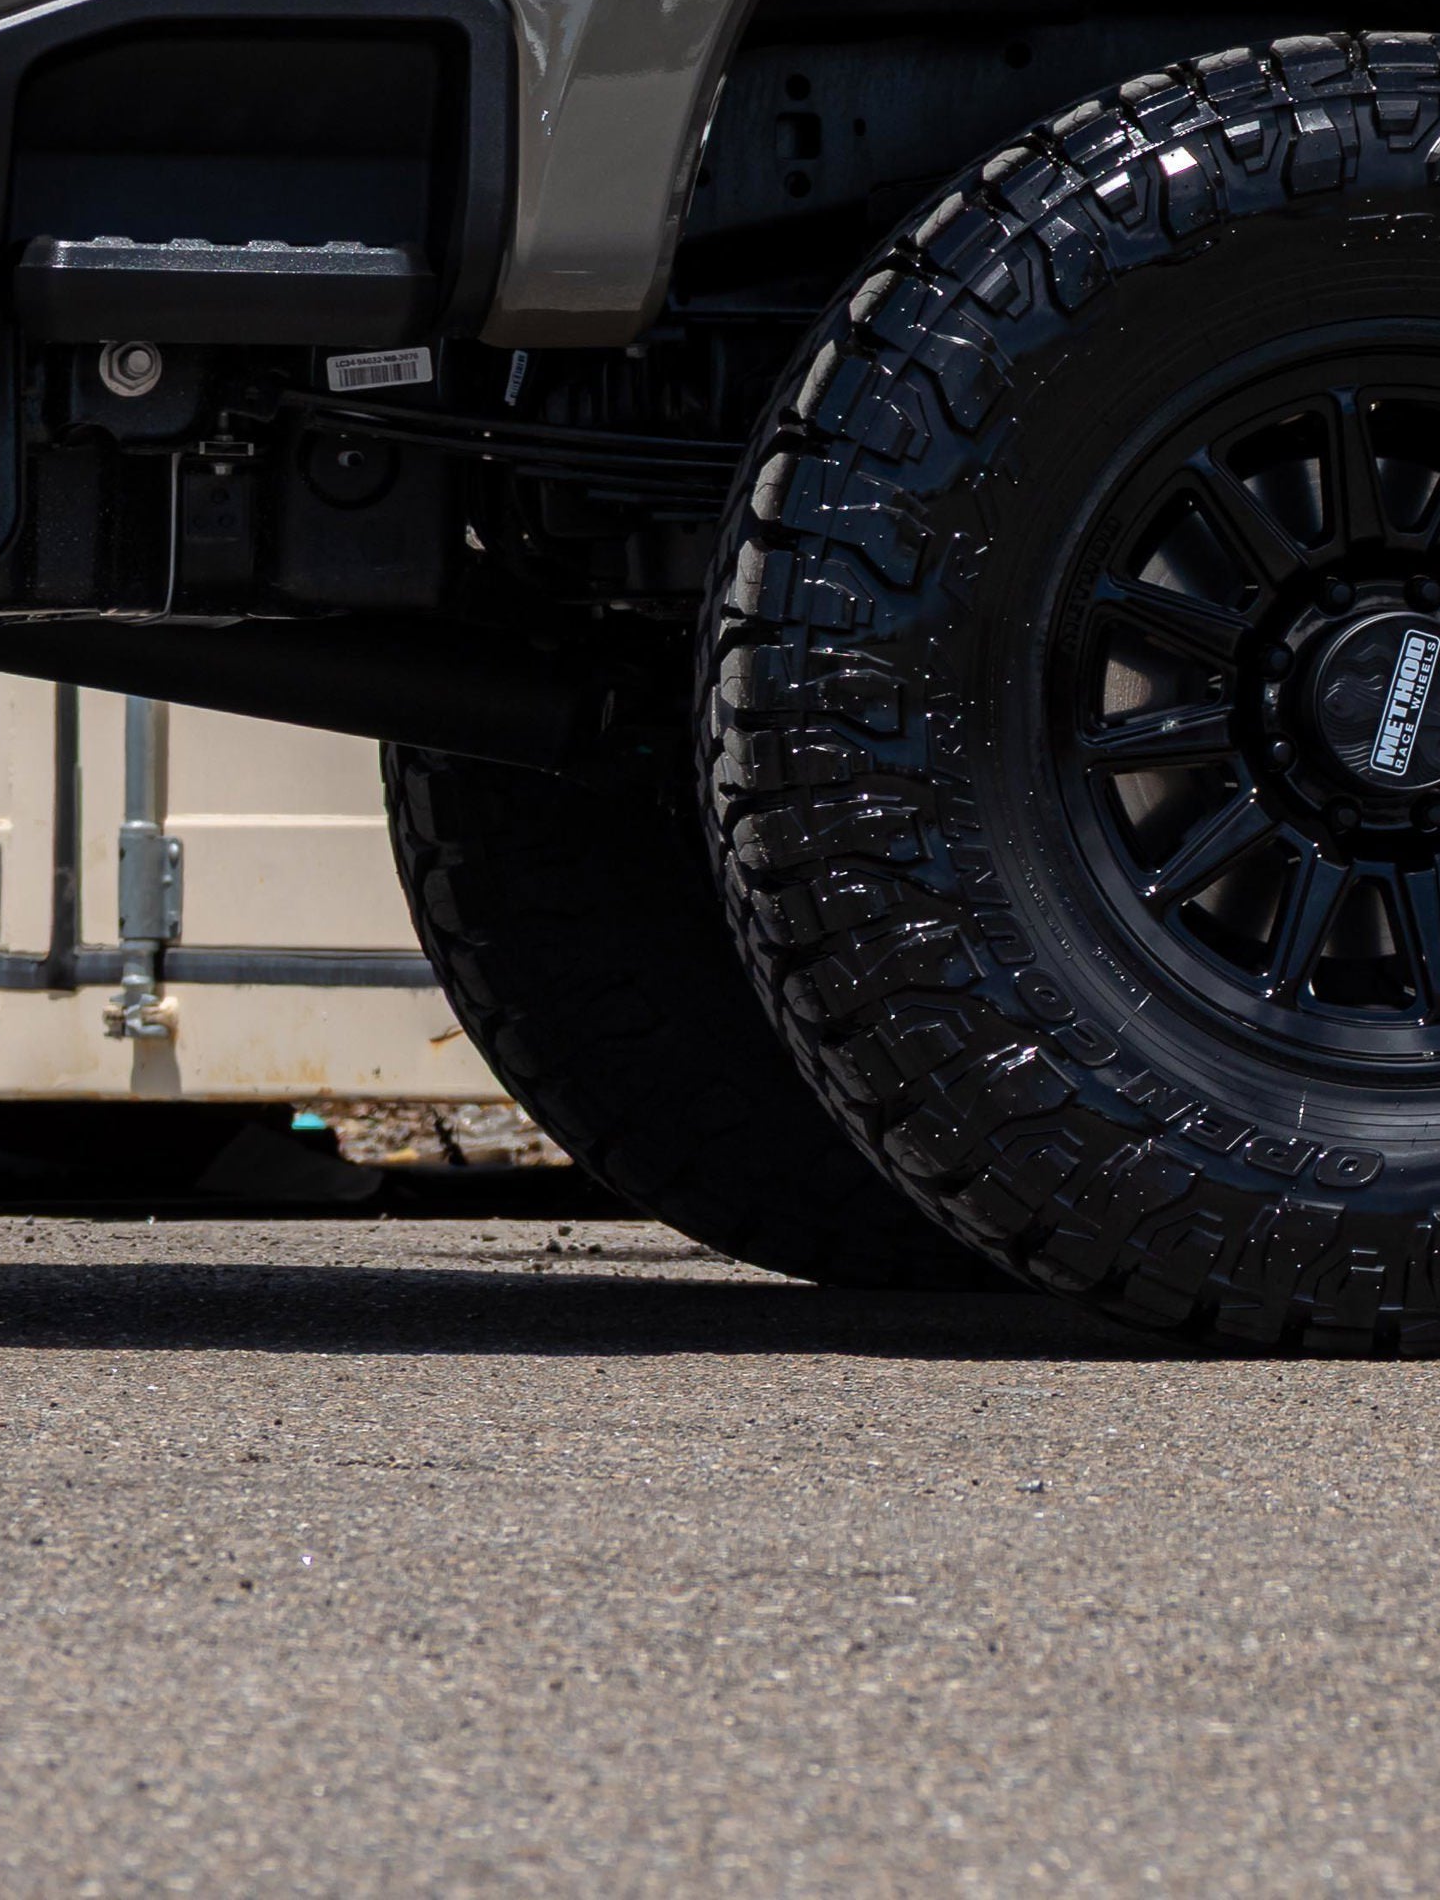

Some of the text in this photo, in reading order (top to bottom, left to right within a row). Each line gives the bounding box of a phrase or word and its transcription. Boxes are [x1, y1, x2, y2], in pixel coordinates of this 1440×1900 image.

[1375, 636, 1426, 767] METHOD
[1394, 641, 1437, 770] RACE WHEELS
[925, 637, 1122, 1068] COUNTRY
[1117, 1068, 1385, 1188] OPEN
